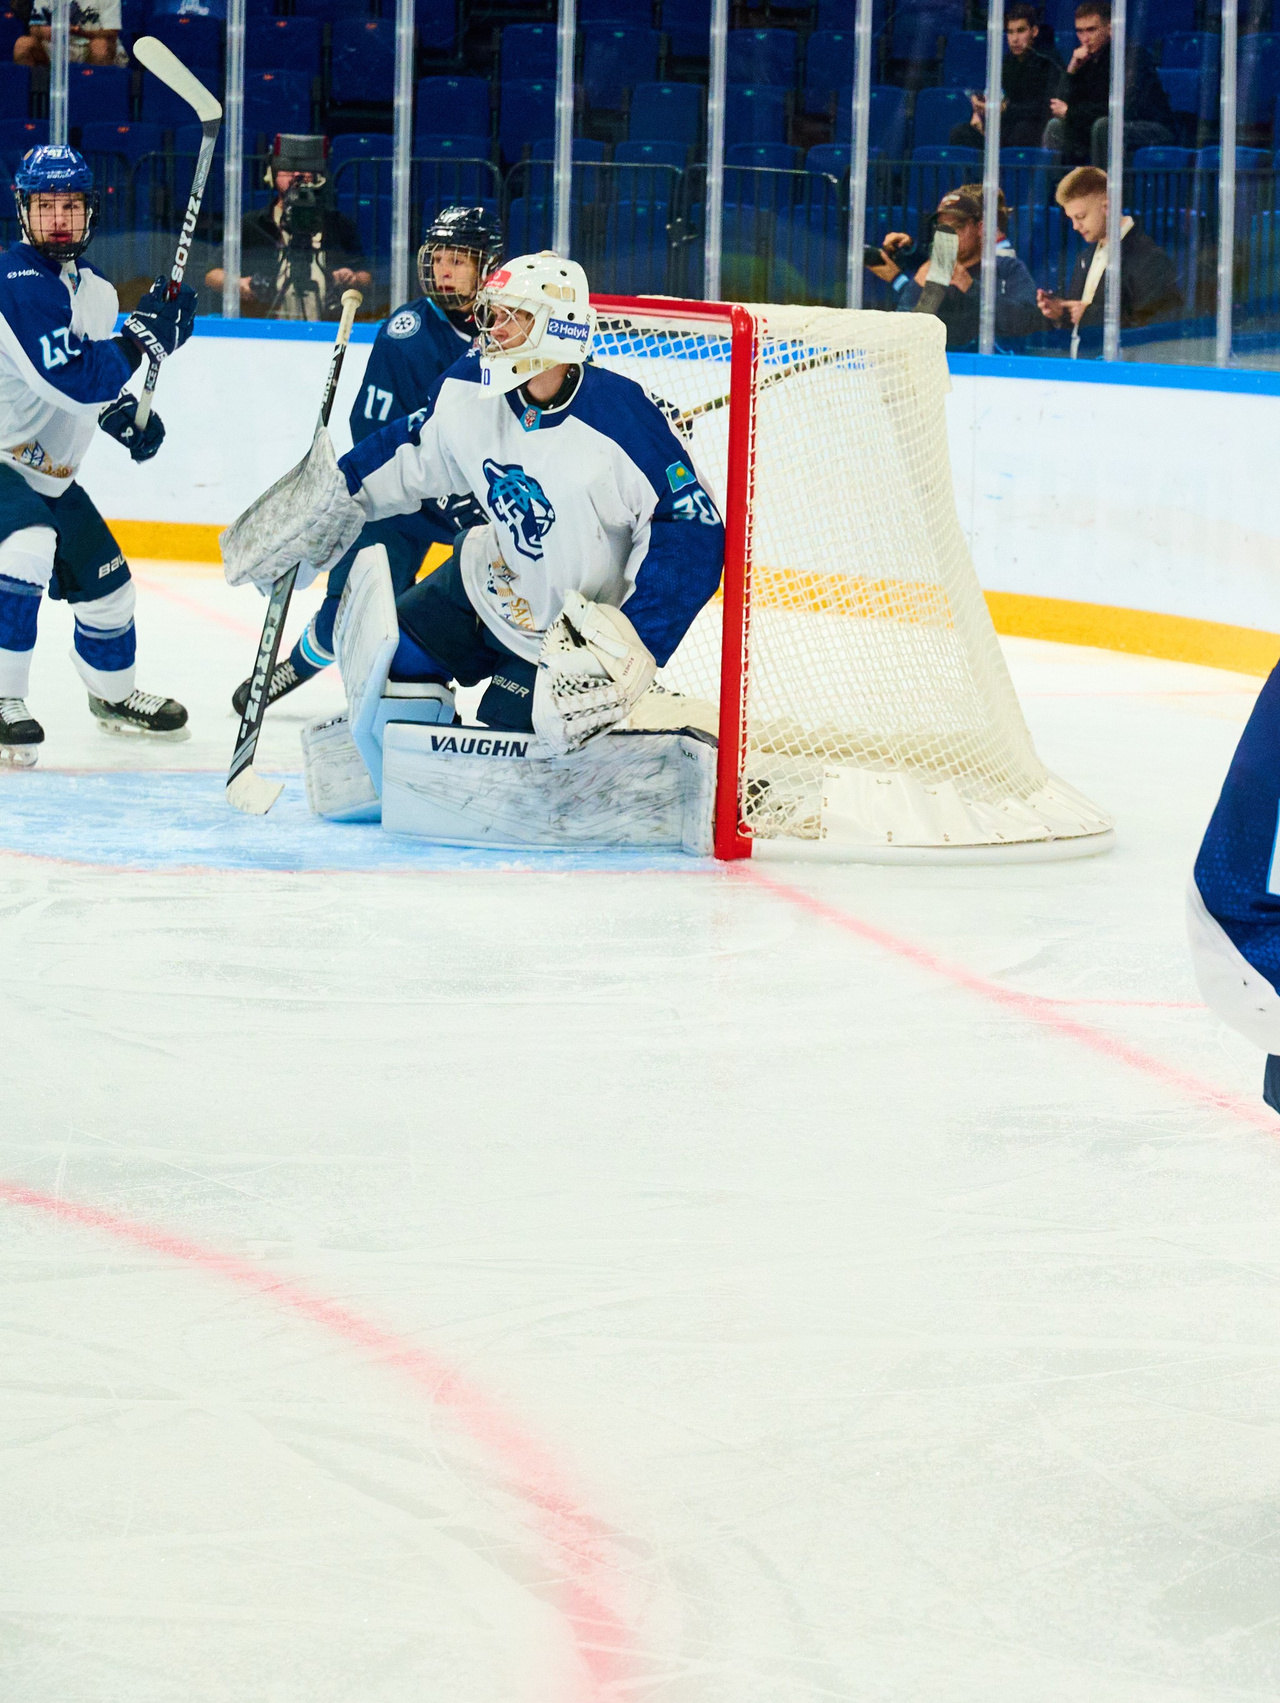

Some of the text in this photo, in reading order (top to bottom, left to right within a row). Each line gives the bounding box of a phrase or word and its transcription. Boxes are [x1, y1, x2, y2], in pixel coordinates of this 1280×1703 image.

[171, 195, 202, 283] SOYUZ
[124, 316, 168, 362] BAUER
[560, 324, 588, 339] Halyk
[364, 384, 393, 421] 17
[244, 603, 282, 722] SOYUZ
[430, 735, 529, 758] VAUGHN
